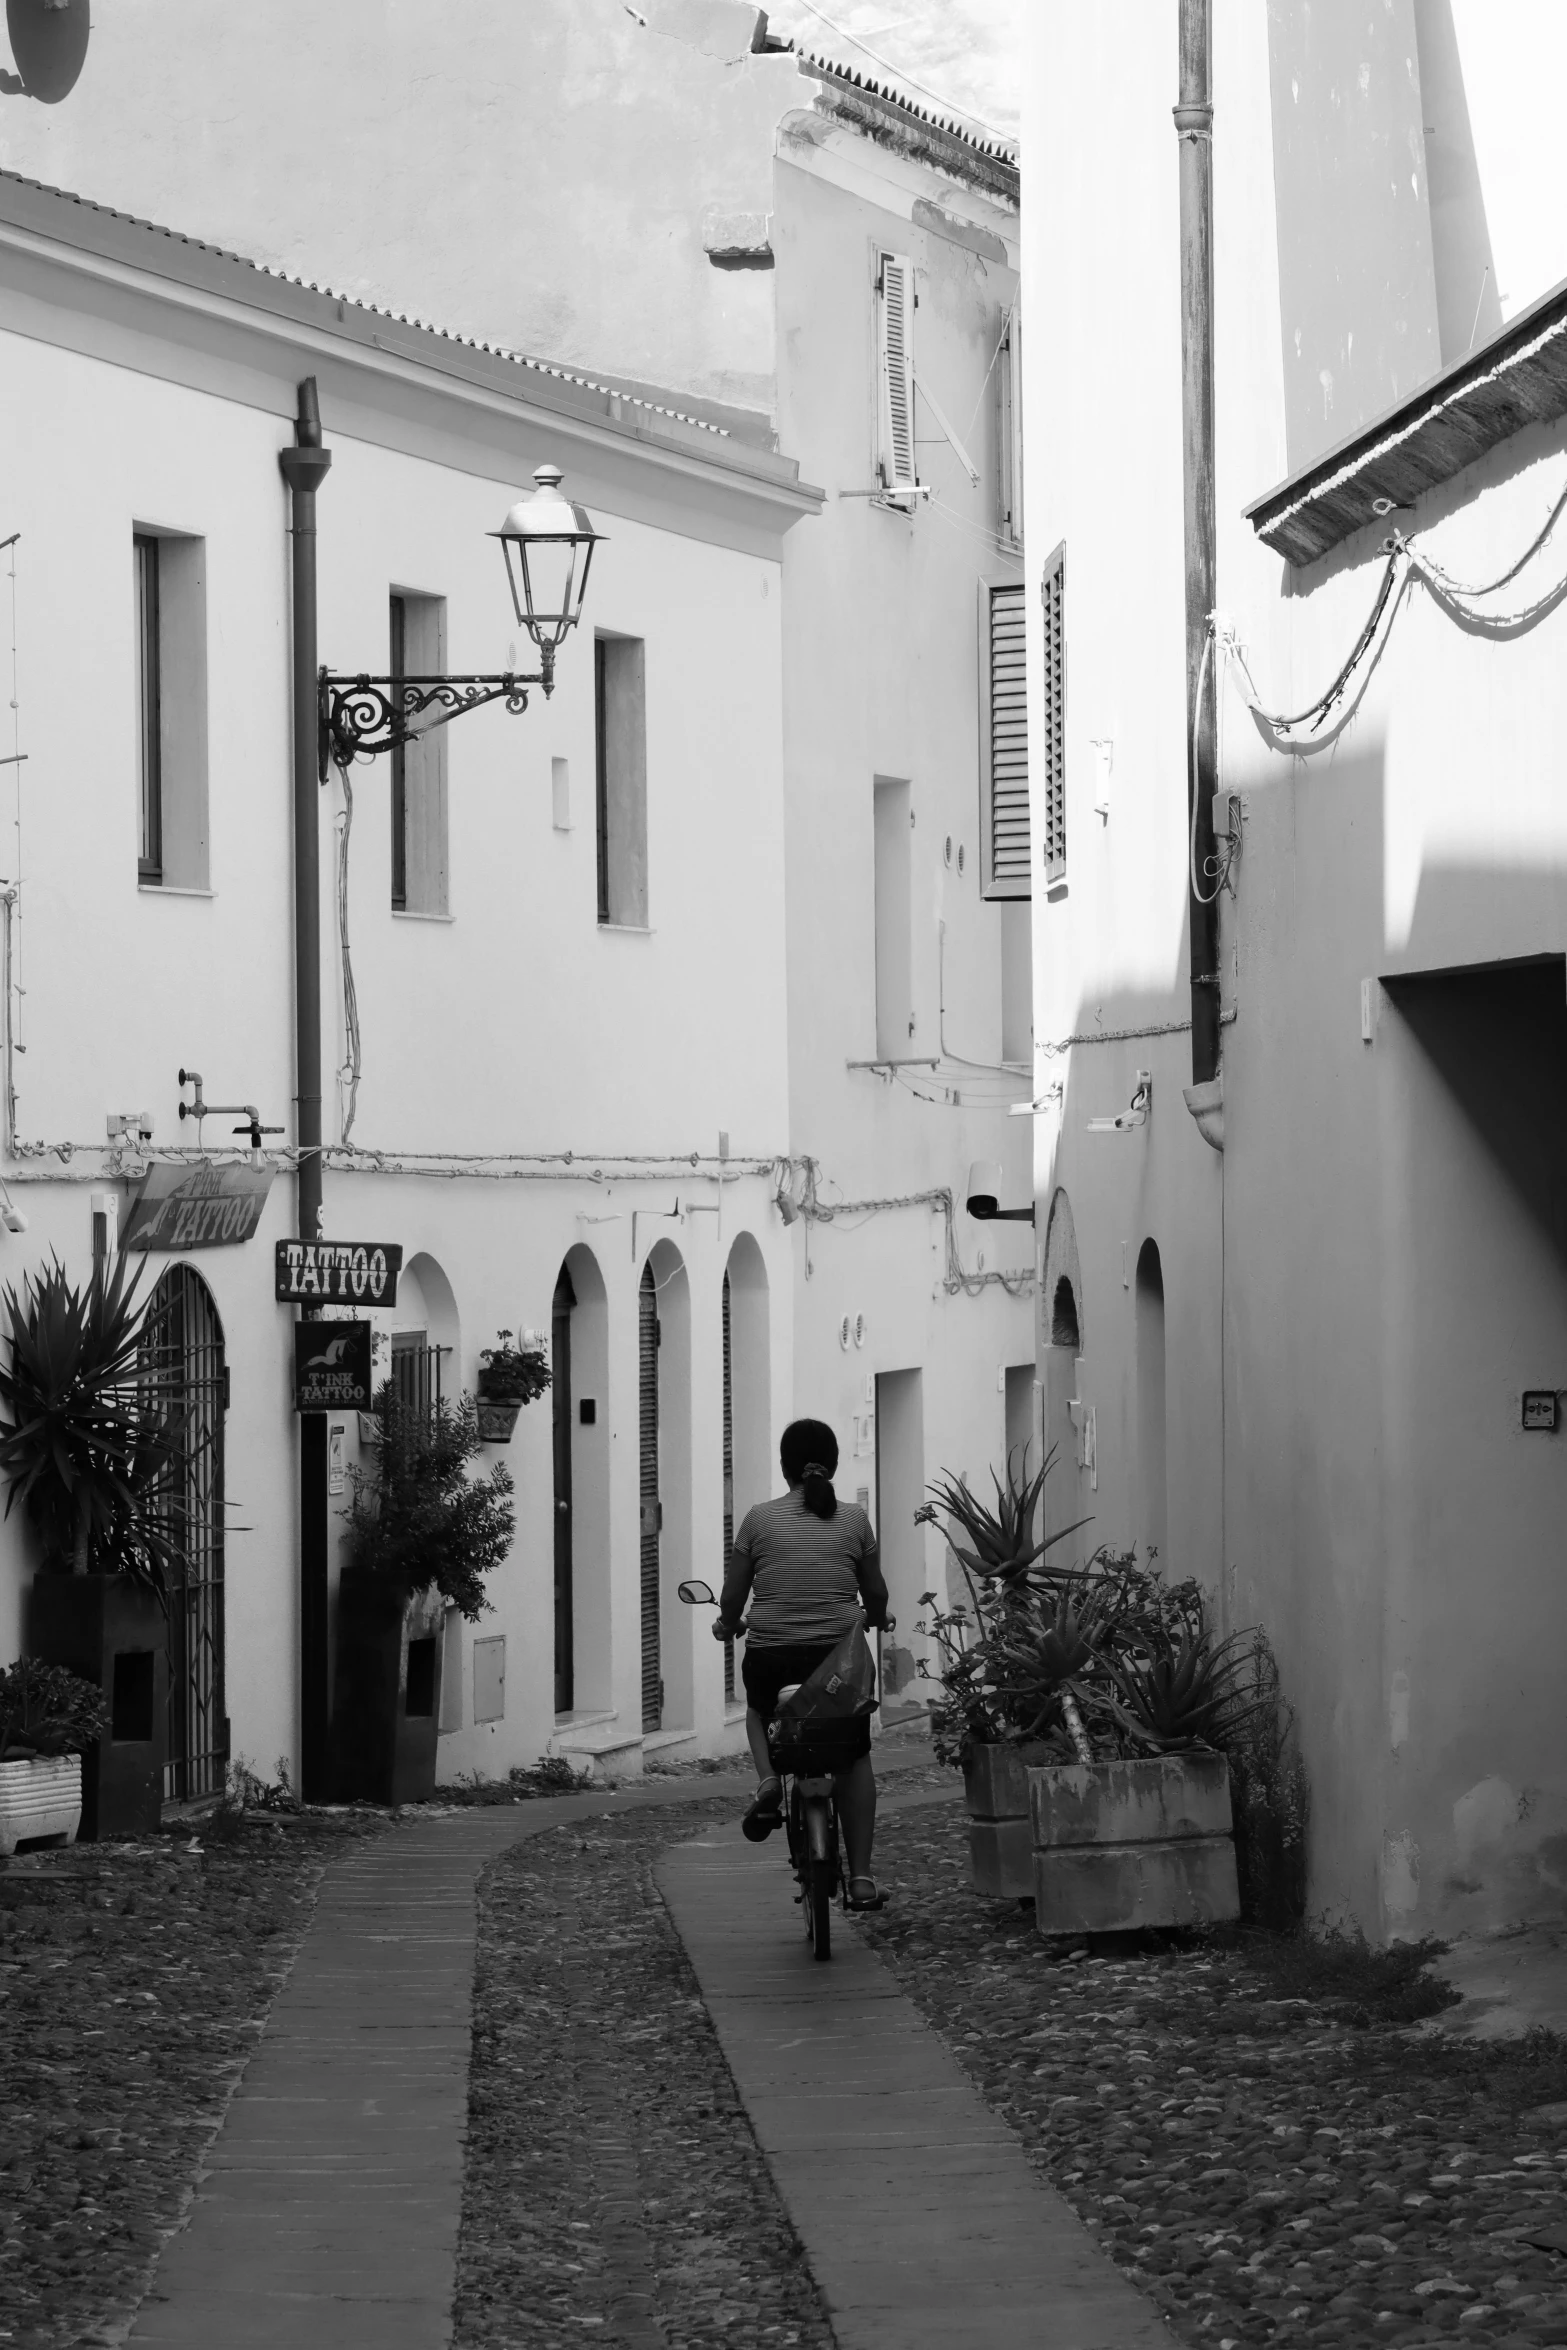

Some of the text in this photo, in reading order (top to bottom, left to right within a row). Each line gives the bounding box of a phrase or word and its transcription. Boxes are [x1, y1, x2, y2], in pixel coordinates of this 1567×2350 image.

[170, 1195, 256, 1244] TATTOO
[286, 1244, 389, 1298] TATTOO
[301, 1386, 365, 1399] TATTOO
[308, 1373, 353, 1385] T'INK
